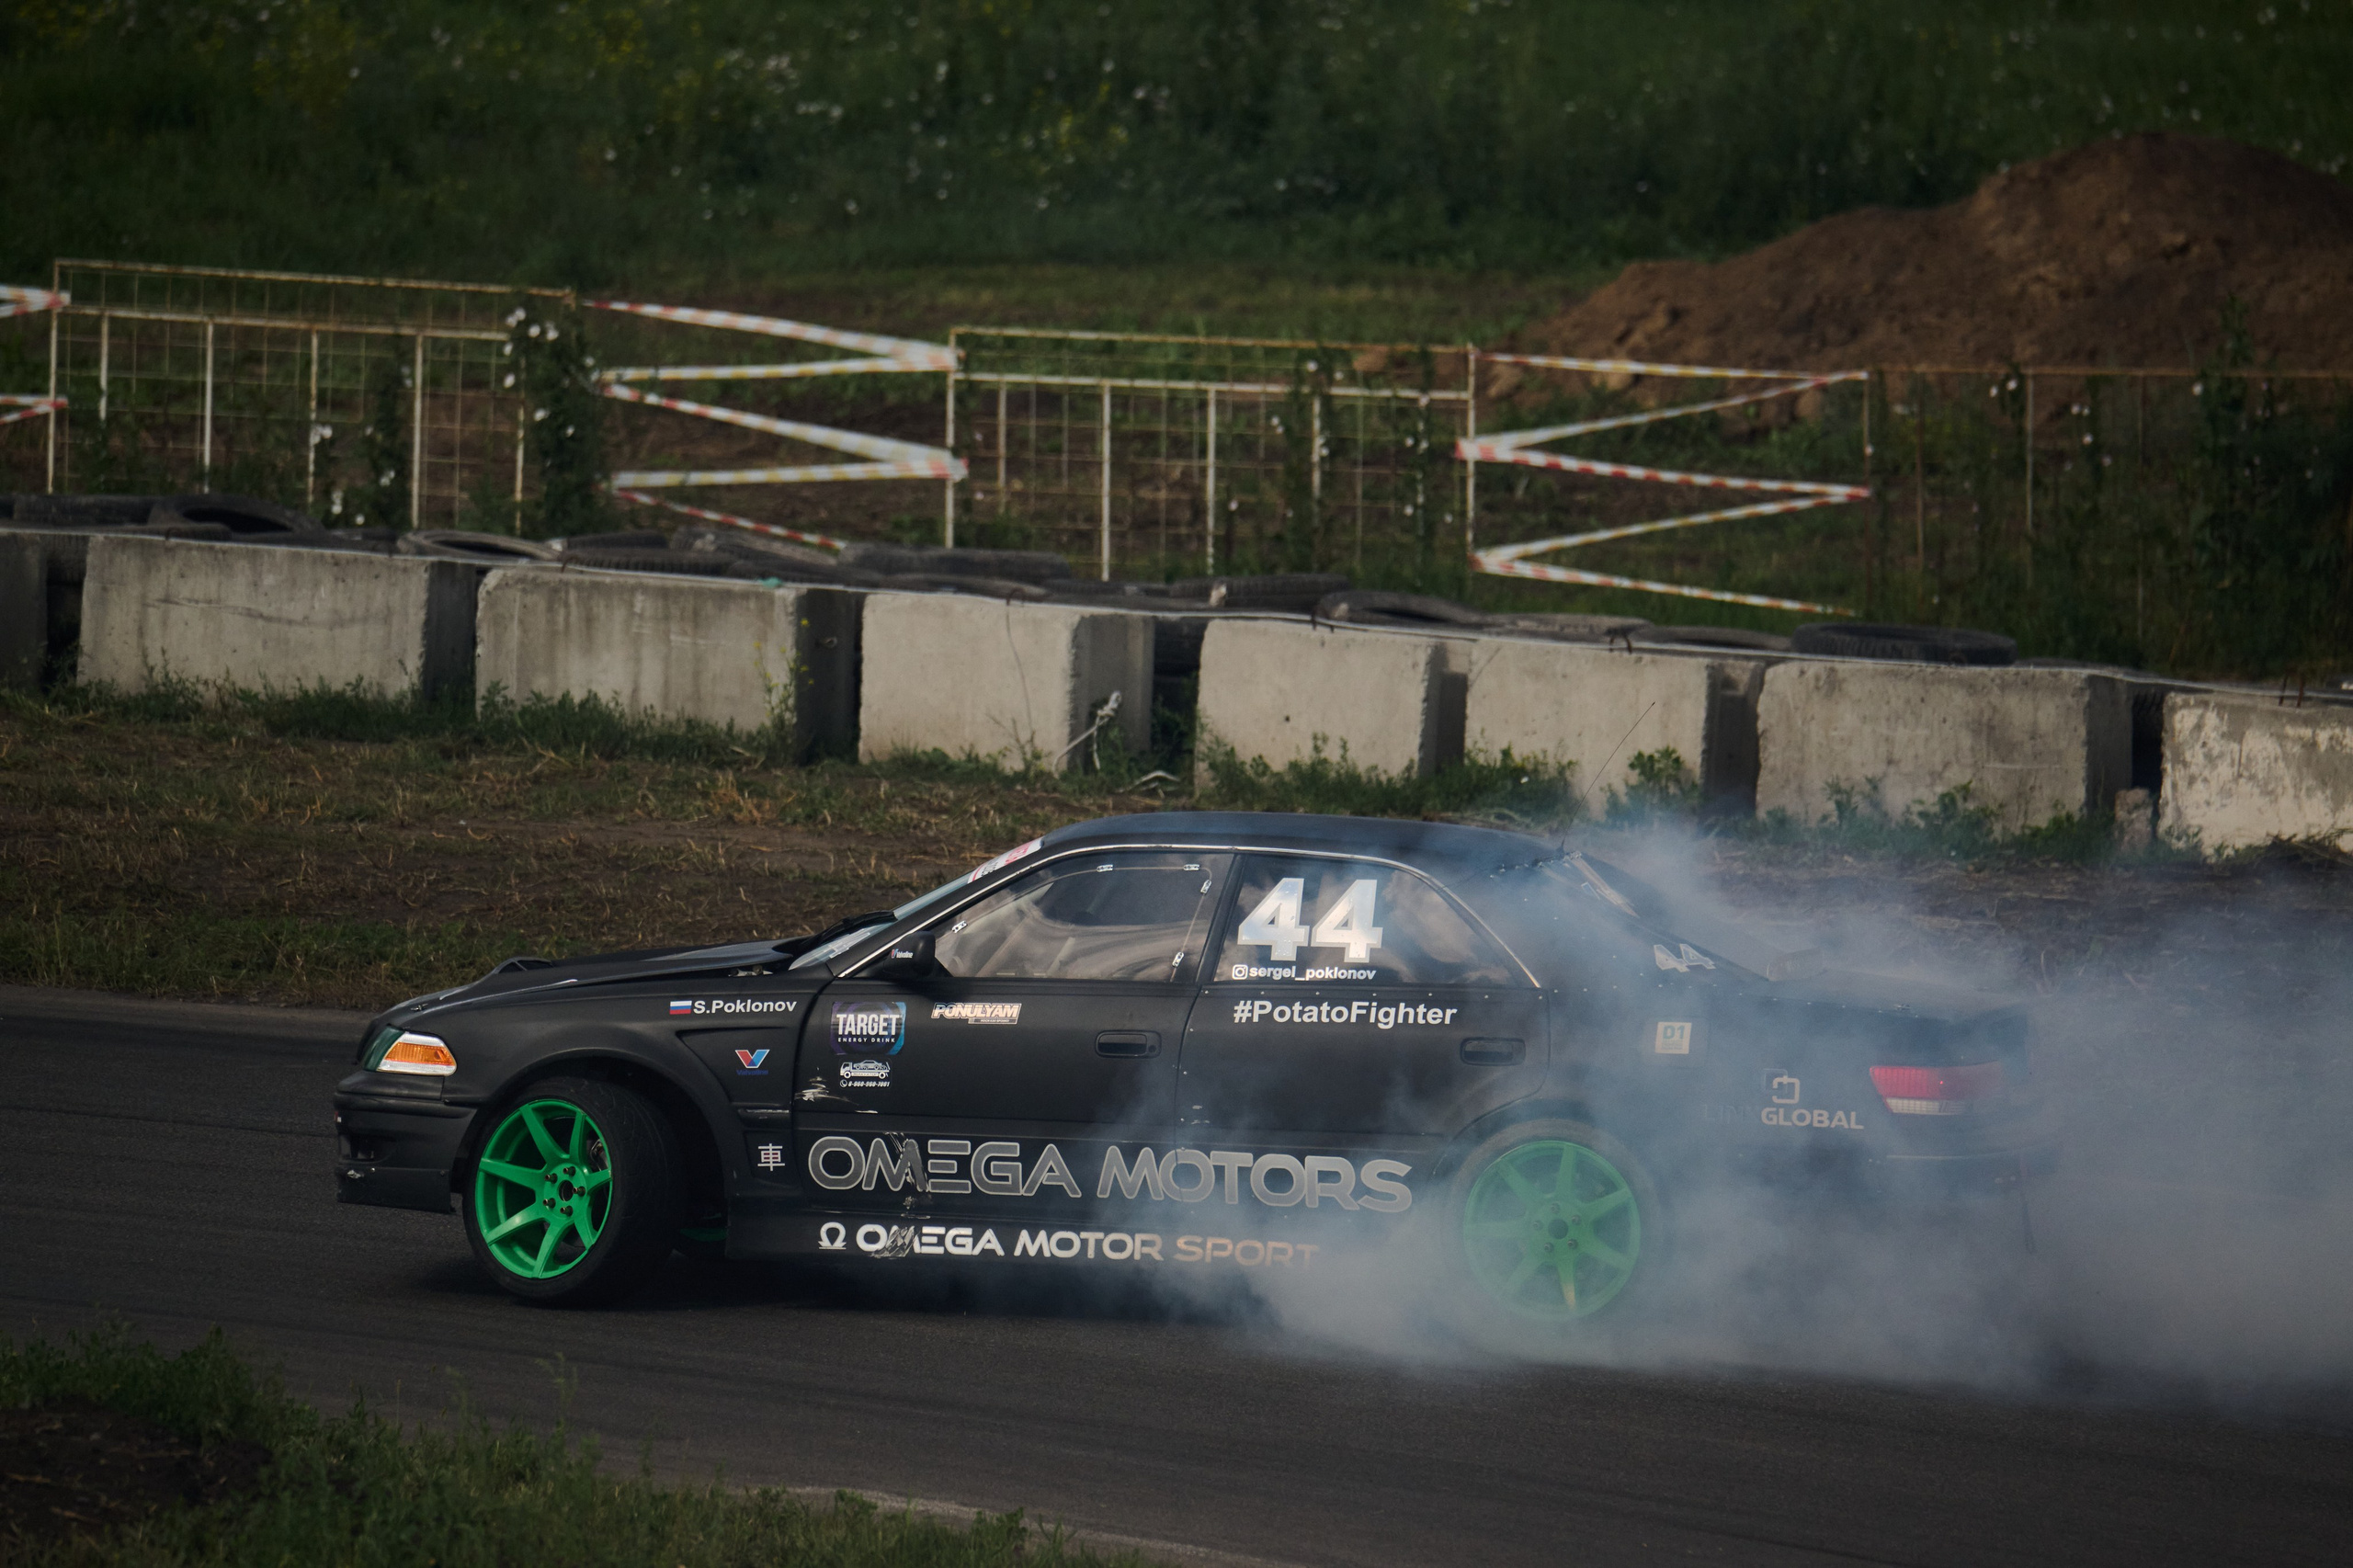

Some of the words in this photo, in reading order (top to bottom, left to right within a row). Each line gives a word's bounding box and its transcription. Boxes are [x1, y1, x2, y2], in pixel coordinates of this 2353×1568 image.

[1237, 878, 1383, 963] 44
[693, 999, 797, 1014] S.Poklonov
[932, 1003, 1020, 1018] PONULYAM
[1233, 1000, 1458, 1029] #PotatoFighter
[836, 1014, 900, 1036] TARGET
[1663, 1025, 1686, 1040] D1
[1761, 1108, 1864, 1130] GLOBAL
[757, 1142, 786, 1172] 車
[808, 1135, 1082, 1199] OMEGA
[1097, 1144, 1413, 1213] MOTORS
[1013, 1229, 1164, 1261] MOTOR
[1173, 1234, 1319, 1269] SPORT
